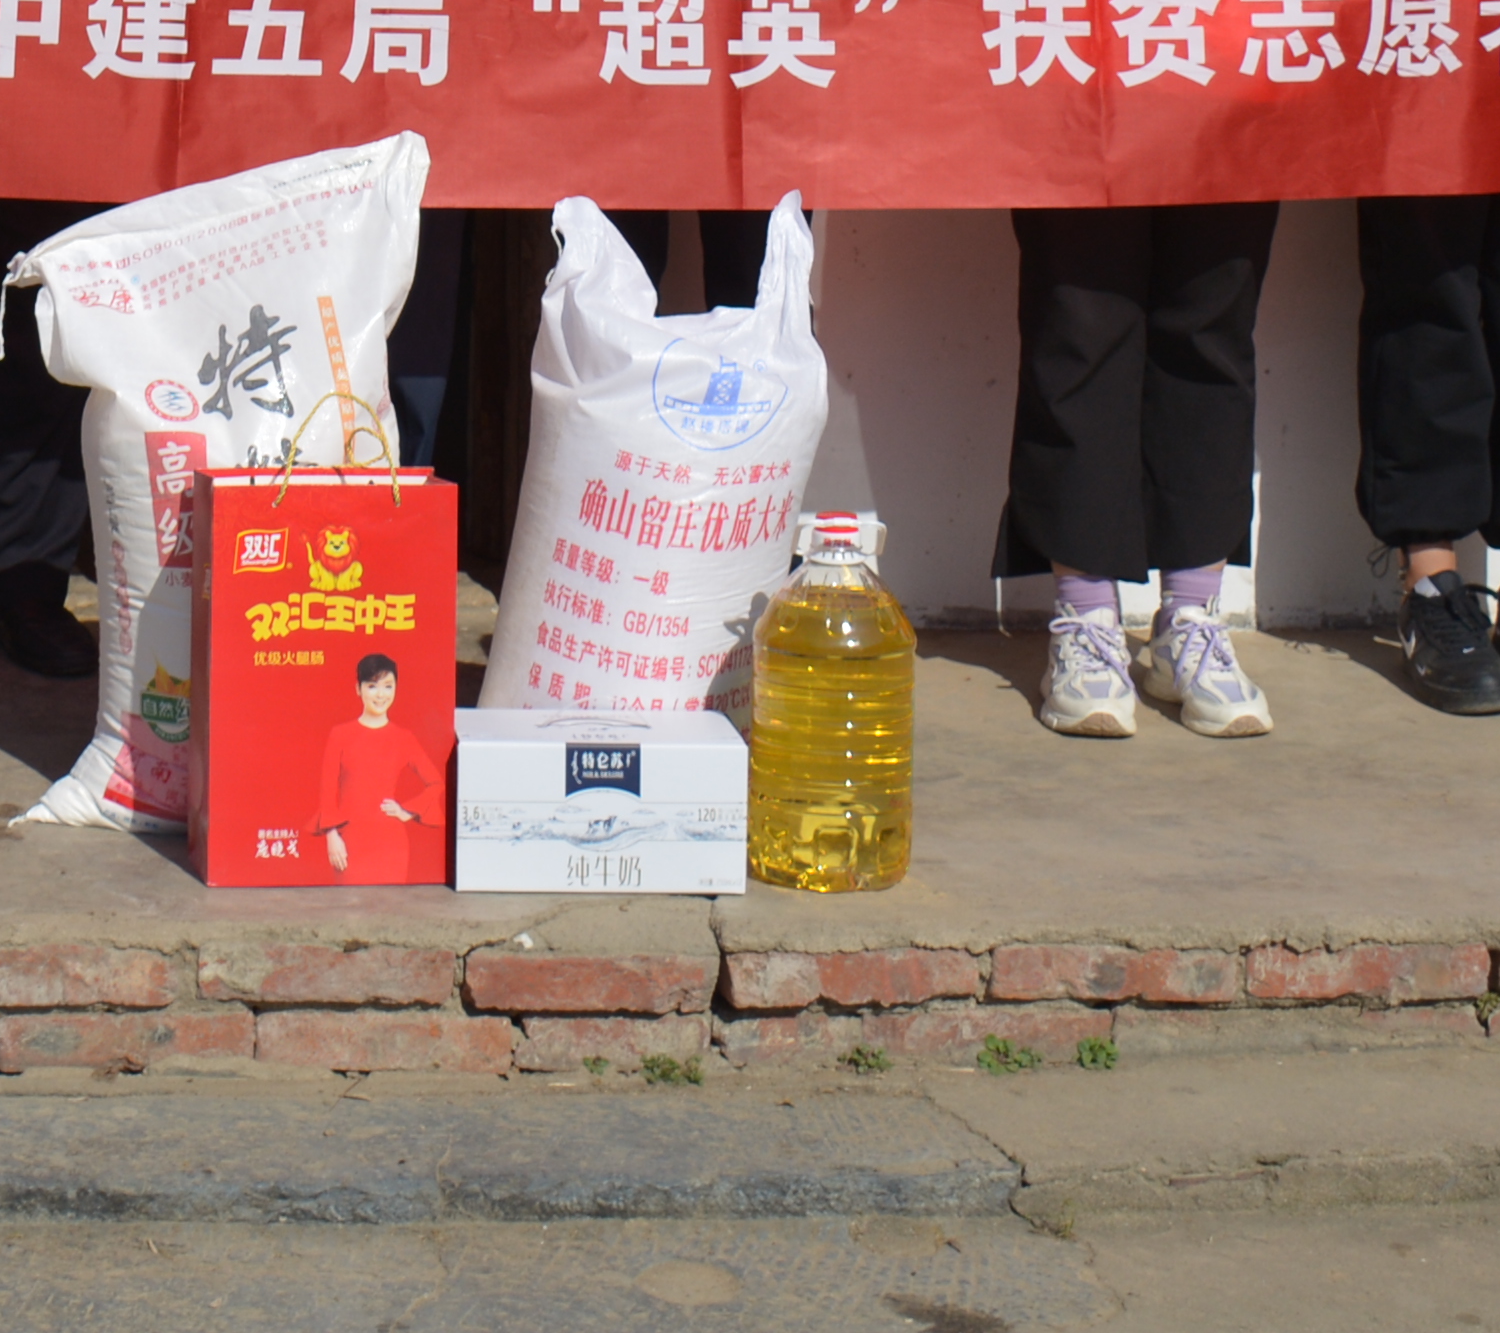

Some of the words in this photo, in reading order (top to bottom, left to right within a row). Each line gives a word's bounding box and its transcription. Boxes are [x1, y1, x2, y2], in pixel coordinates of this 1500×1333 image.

[614, 448, 693, 485] 源于天然
[712, 459, 792, 487] 无公害大米
[578, 478, 796, 554] 确山留庄优质大米
[239, 533, 282, 560] 双汇
[244, 591, 416, 643] 双汇王中王
[253, 650, 325, 667] 优级火腿肠
[581, 750, 625, 770] 特仑苏
[697, 807, 717, 822] 120
[566, 854, 642, 887] 纯牛奶
